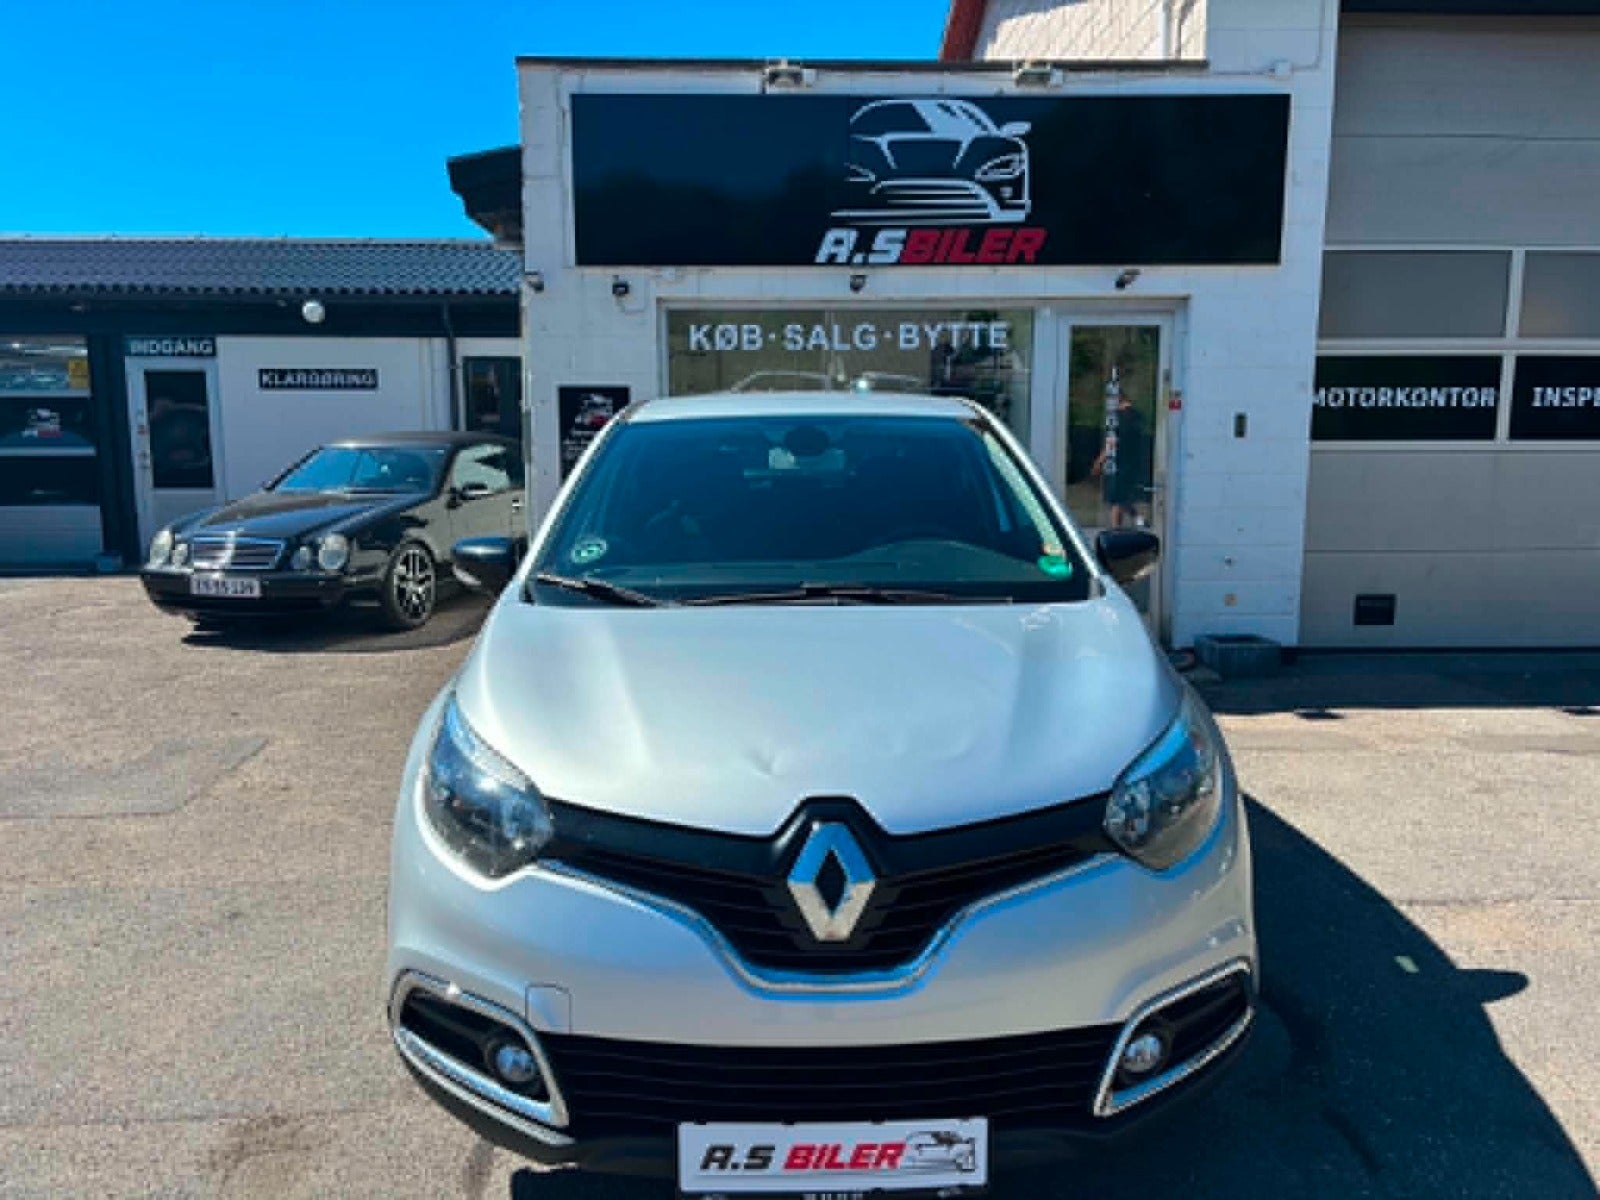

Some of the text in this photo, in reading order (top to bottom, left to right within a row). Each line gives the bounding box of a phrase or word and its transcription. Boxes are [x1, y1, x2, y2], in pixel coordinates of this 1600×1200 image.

[688, 321, 1009, 350] KØB SALG BYTTE
[700, 1142, 906, 1170] A.S BILER
